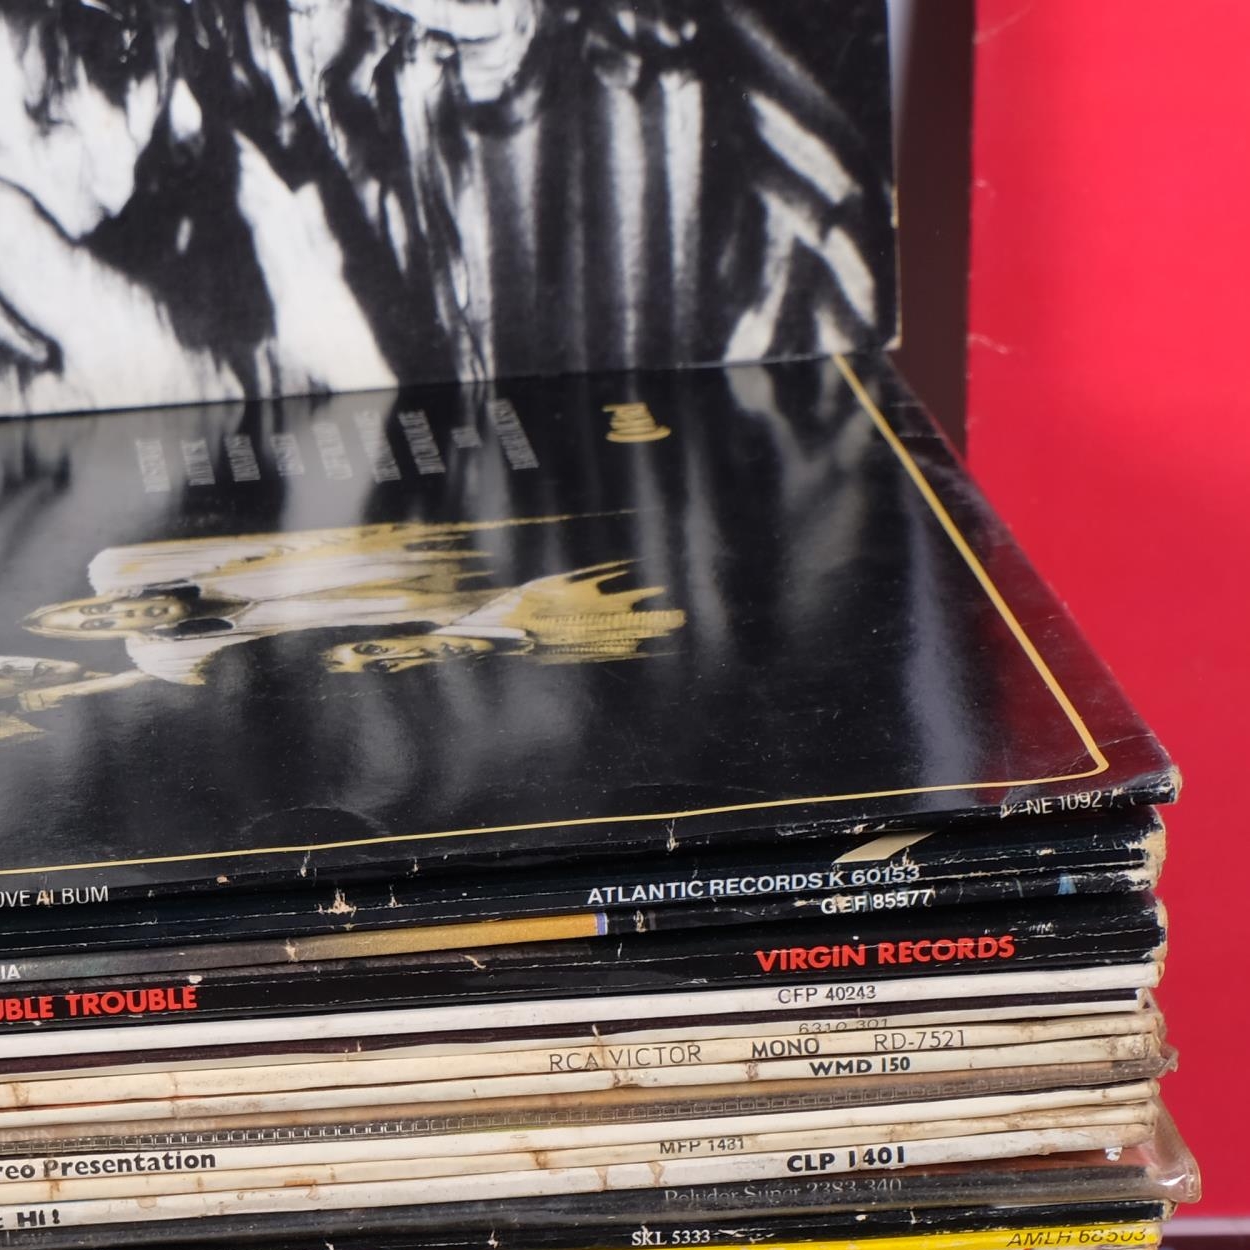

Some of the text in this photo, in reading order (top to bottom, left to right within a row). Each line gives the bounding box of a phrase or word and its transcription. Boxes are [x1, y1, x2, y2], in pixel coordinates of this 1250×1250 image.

[1027, 791, 1102, 815] NE 1092
[36, 886, 109, 907] ALBUM
[587, 866, 920, 904] ATLANTIC RECORDS K 60153
[756, 936, 1015, 972] VIRGIN RECORDS
[65, 986, 198, 1016] TROUBLE
[778, 985, 876, 1004] CFP 40243
[752, 1031, 966, 1058] MONO RD-7521
[549, 1044, 702, 1072] RCA VICTOR
[810, 1058, 910, 1074] WMD 150
[44, 1153, 216, 1177] Presentation
[631, 1228, 710, 1247] SKL 5333
